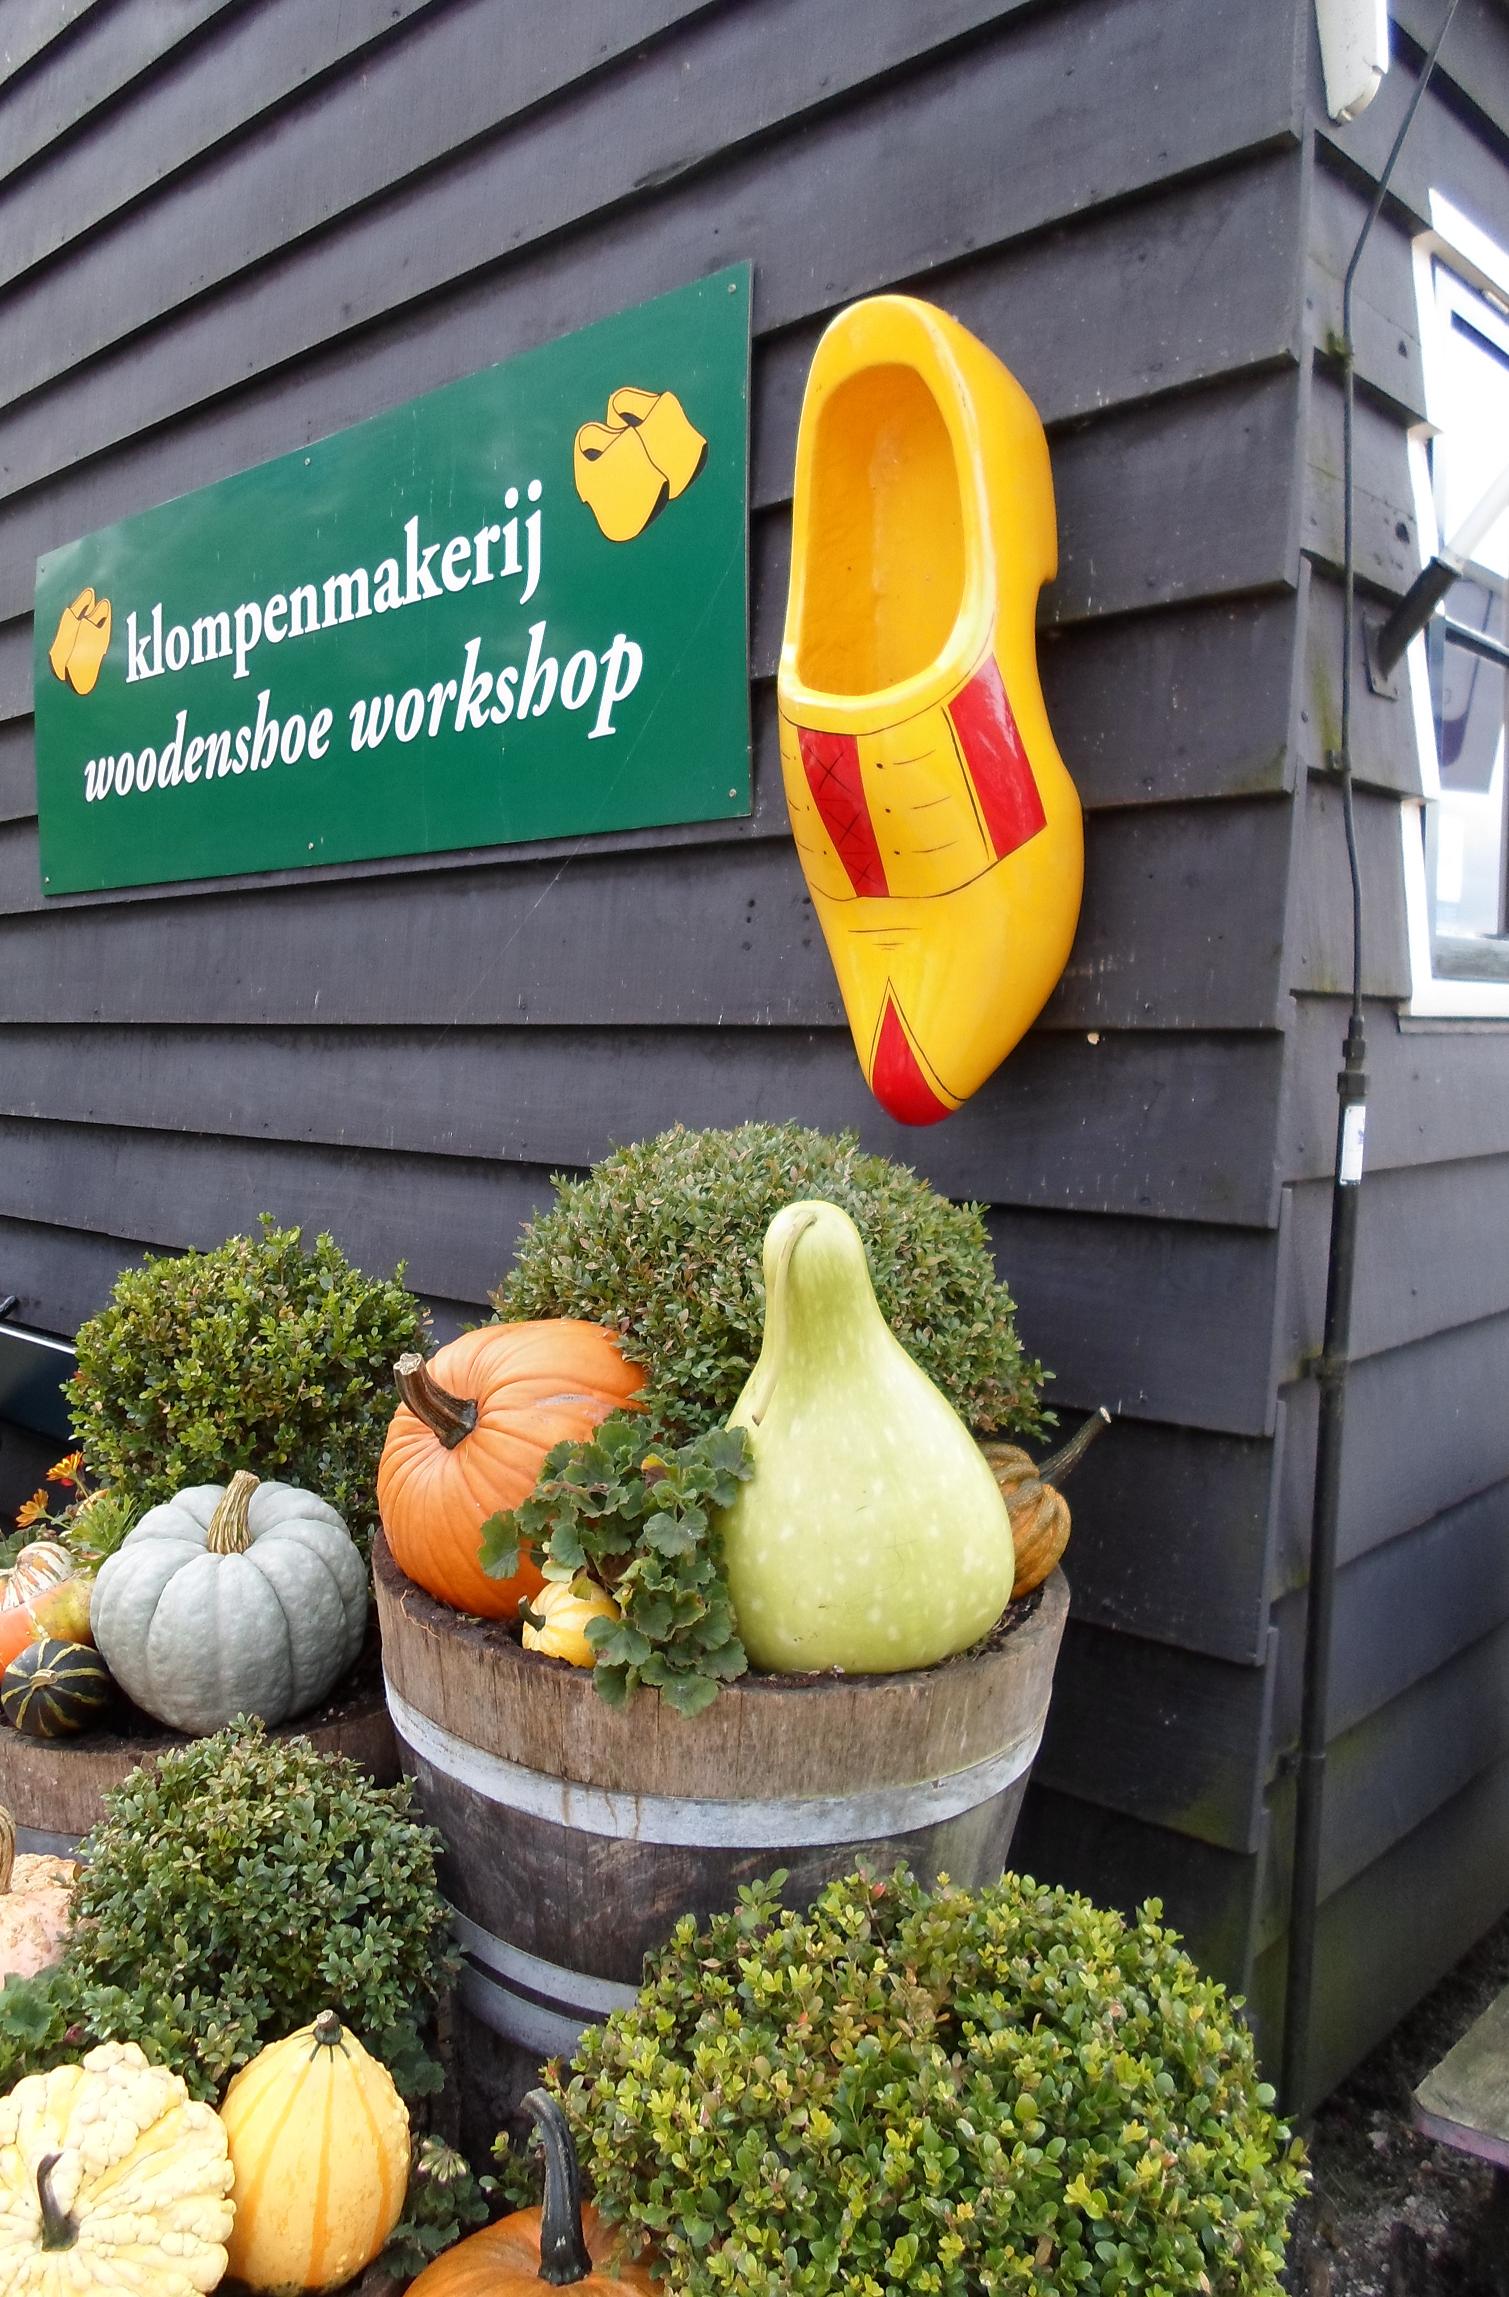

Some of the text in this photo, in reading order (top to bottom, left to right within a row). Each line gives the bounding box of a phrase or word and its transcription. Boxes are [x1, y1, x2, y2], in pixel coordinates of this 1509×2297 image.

[125, 479, 543, 684] klompenmakerij
[84, 620, 643, 802] woodenshoe workshop
